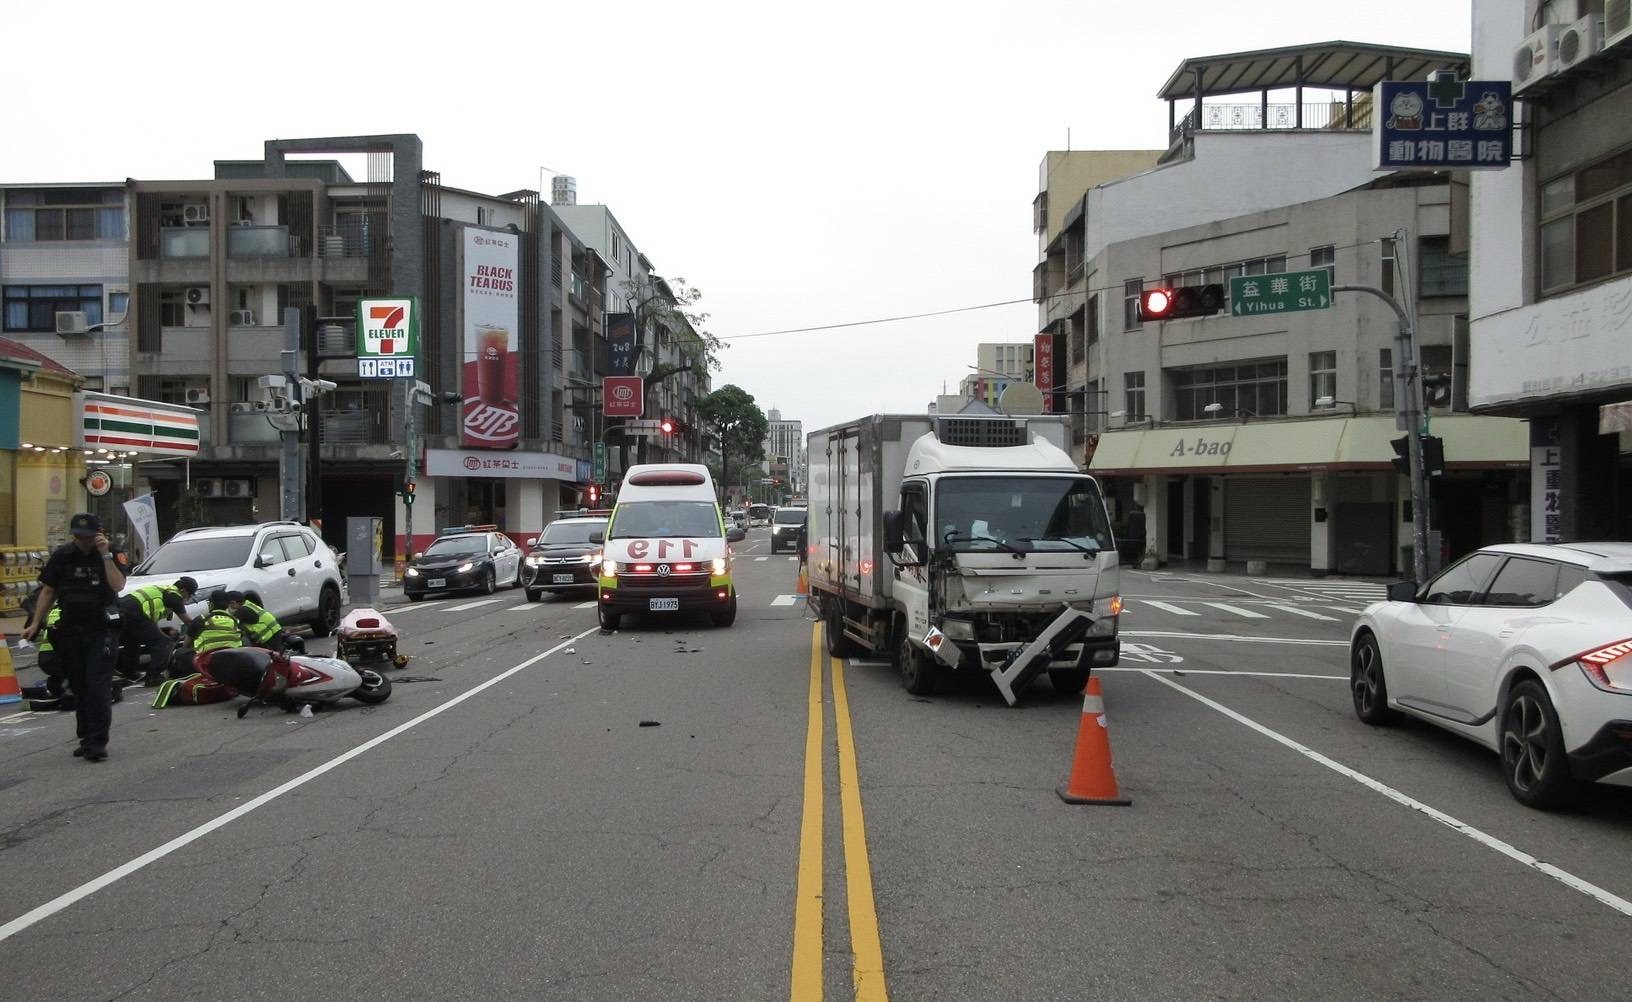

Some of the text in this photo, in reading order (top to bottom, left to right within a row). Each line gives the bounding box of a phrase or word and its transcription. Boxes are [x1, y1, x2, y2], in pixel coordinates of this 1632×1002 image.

[1424, 111, 1468, 130] 上群
[1389, 140, 1503, 161] 動物醫院
[477, 264, 513, 280] BLACK
[1242, 275, 1317, 298] 益華街
[1246, 297, 1316, 312] Yihua St.
[1169, 438, 1233, 457] A-bao
